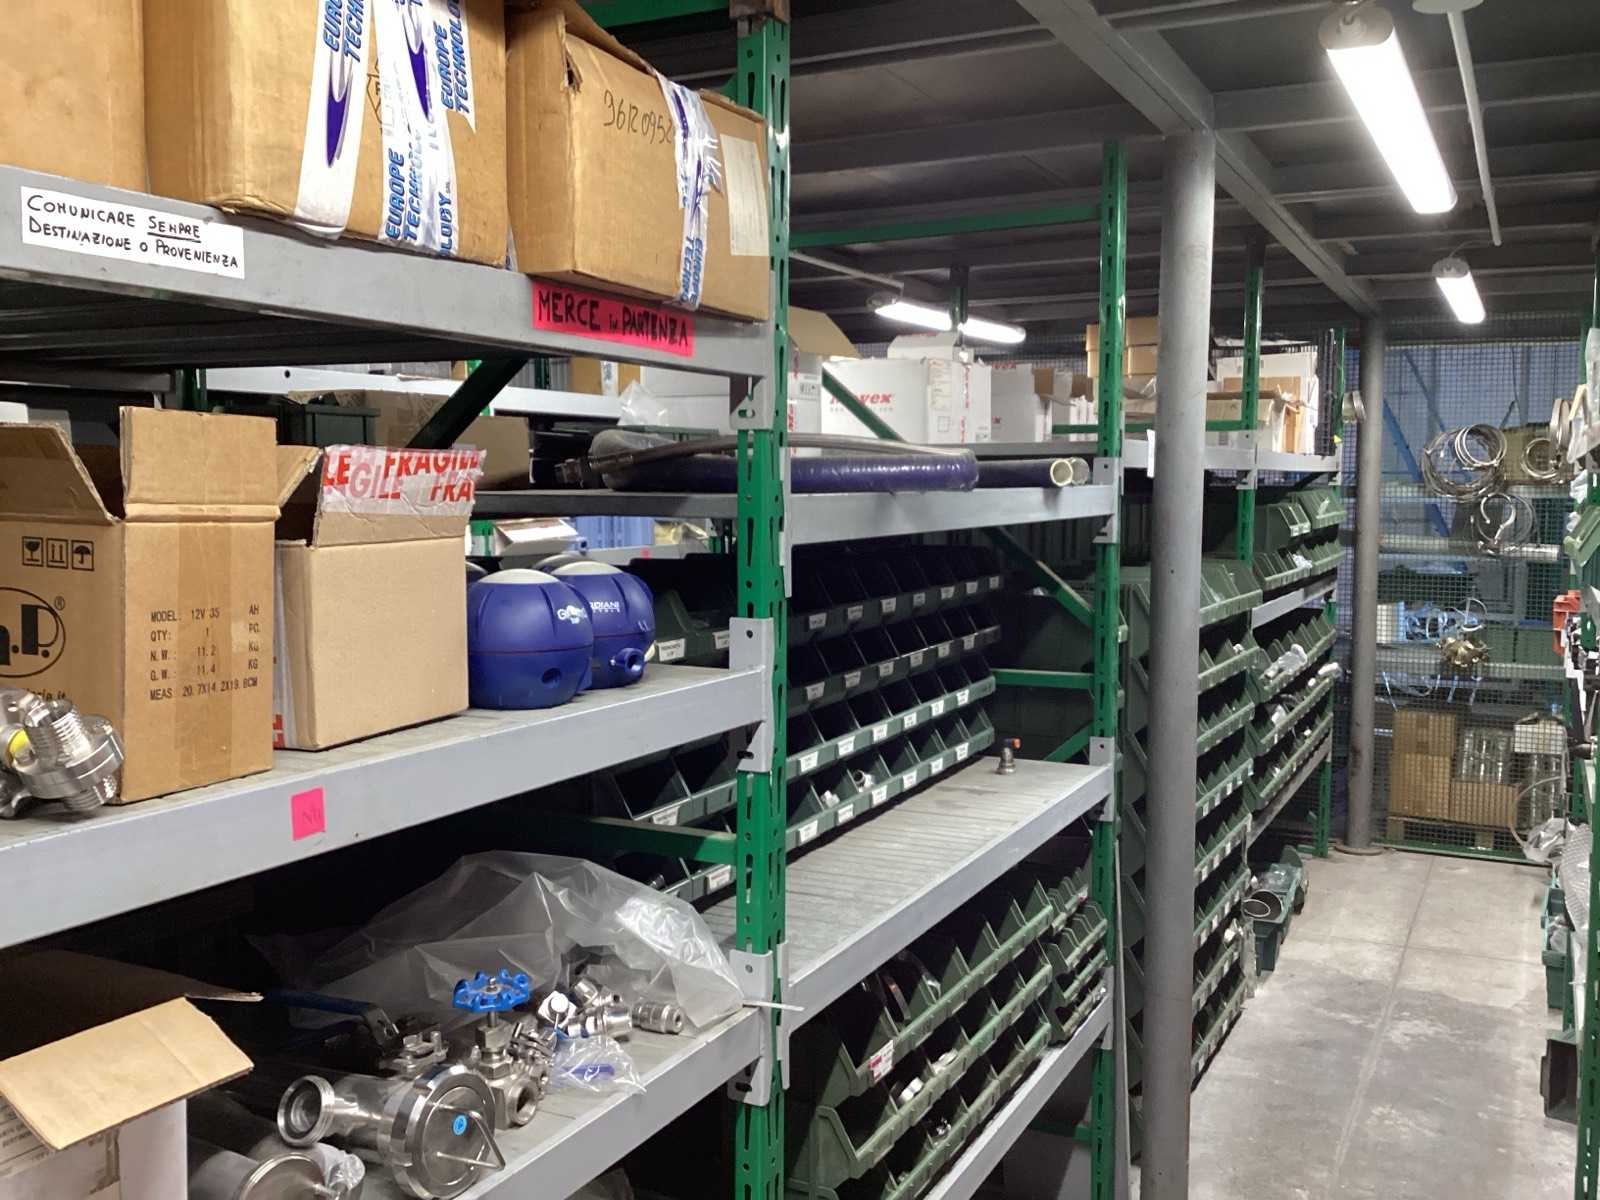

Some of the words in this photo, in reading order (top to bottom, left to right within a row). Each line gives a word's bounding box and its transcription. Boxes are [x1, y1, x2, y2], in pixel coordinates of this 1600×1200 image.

[433, 20, 454, 110] EUROPE
[27, 194, 136, 228] COMUNICARE
[148, 215, 201, 240] SEMPRE
[385, 147, 406, 241] EUROPE
[29, 215, 132, 251] DESTINAZIONE
[155, 238, 239, 269] PROVENIENZA
[538, 289, 601, 332] MERCE
[622, 306, 688, 347] PARTENZA
[249, 604, 259, 615] AH
[151, 630, 172, 642] QTY:
[248, 658, 258, 670] KG
